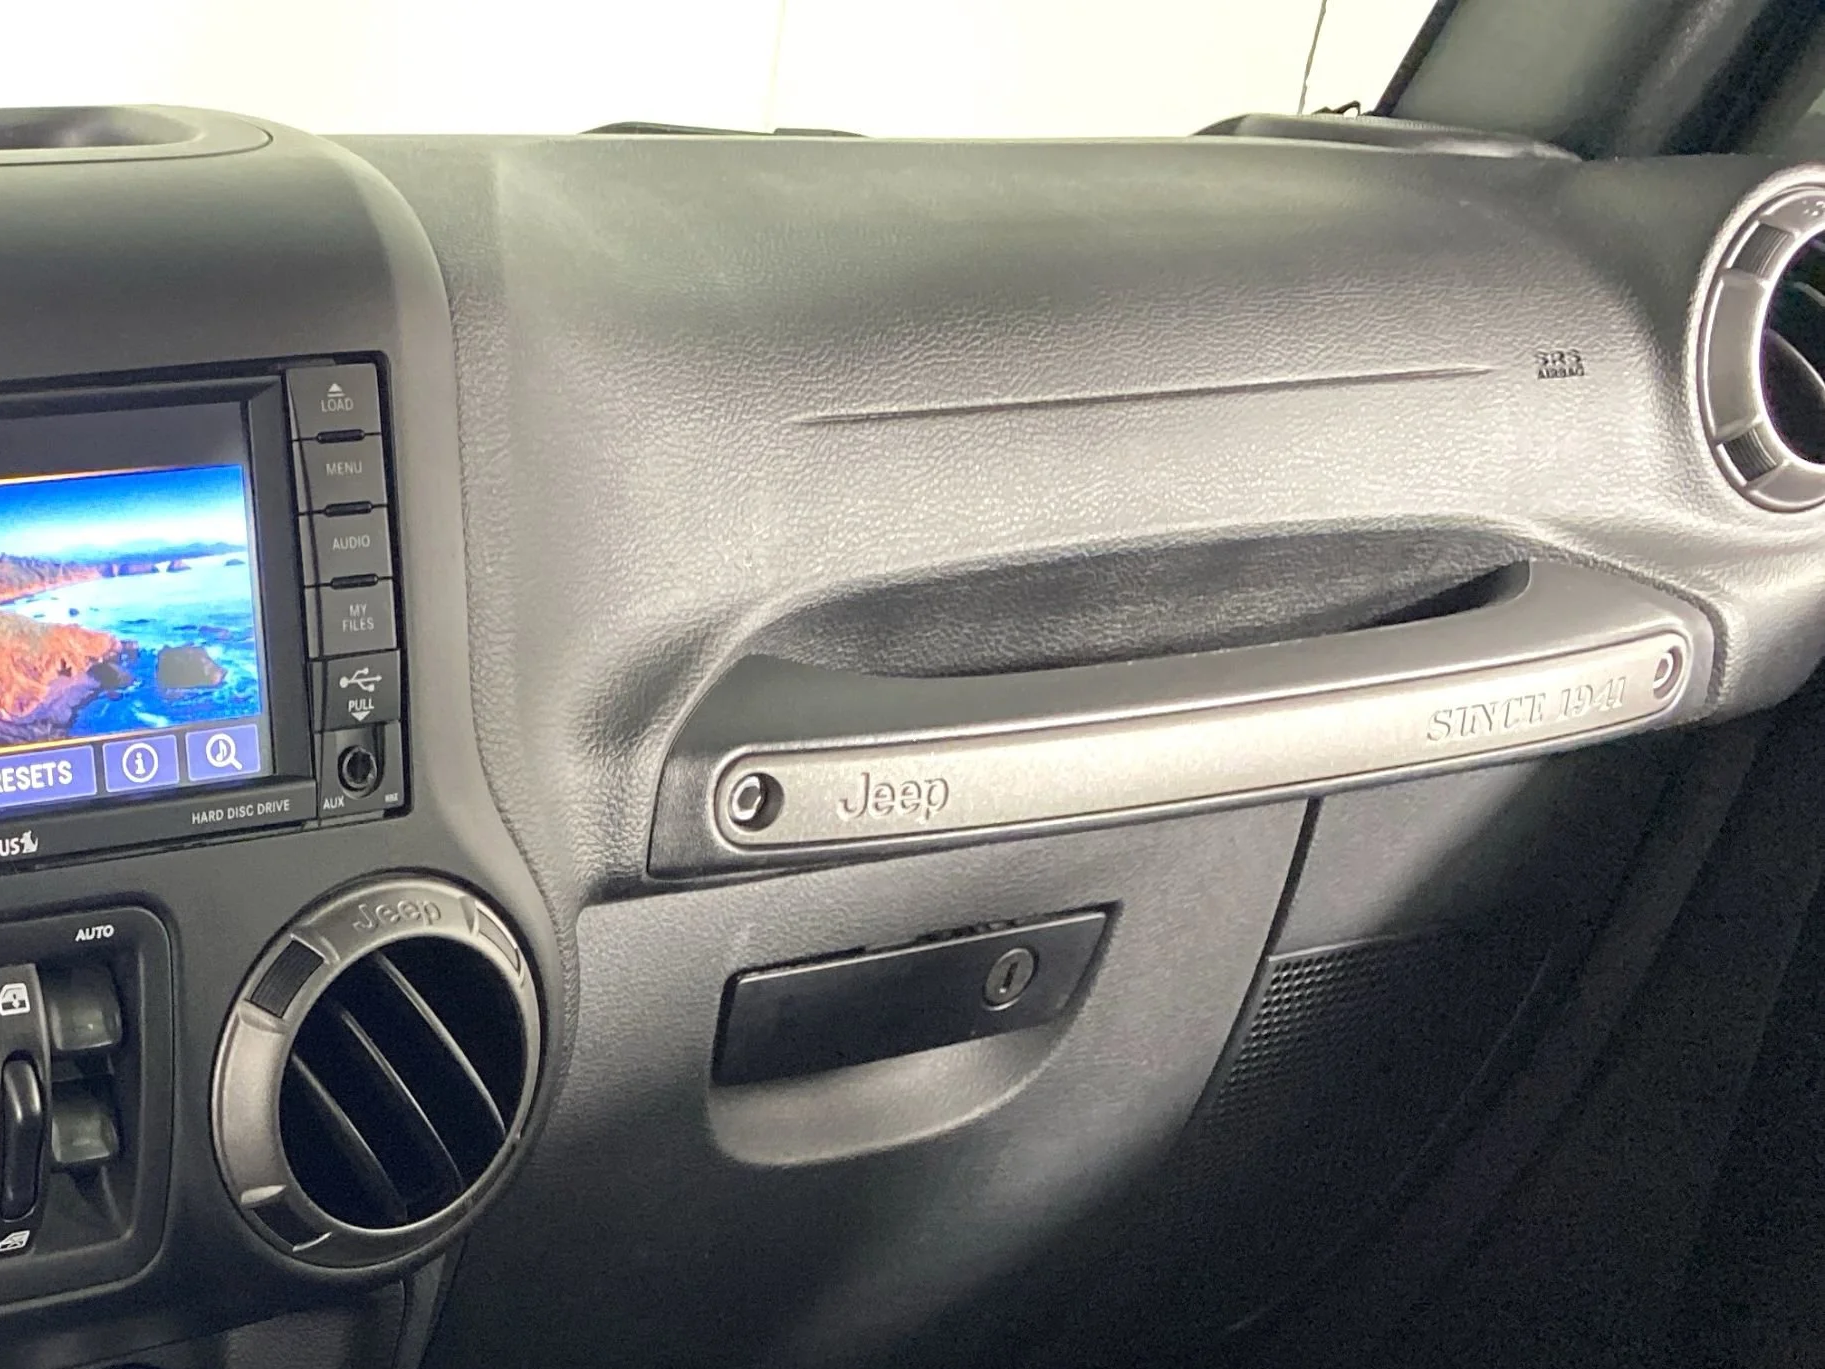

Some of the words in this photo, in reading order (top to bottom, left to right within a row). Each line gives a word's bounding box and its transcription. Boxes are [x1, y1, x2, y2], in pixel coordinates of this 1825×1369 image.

[321, 398, 354, 412] LOAD
[326, 461, 363, 476] MENU
[332, 535, 371, 550] AUDIO
[349, 604, 367, 617] MY
[342, 617, 374, 632] FILES
[348, 698, 374, 712] PULL
[1426, 692, 1547, 743] SINCE
[1558, 676, 1627, 719] 1941
[323, 796, 344, 810] AUX
[838, 771, 950, 822] Jeep
[191, 810, 224, 825] HARD
[227, 805, 254, 821] DISC
[256, 799, 291, 817] DRIVE
[352, 899, 442, 933] Jeep
[75, 924, 115, 942] AUTO
